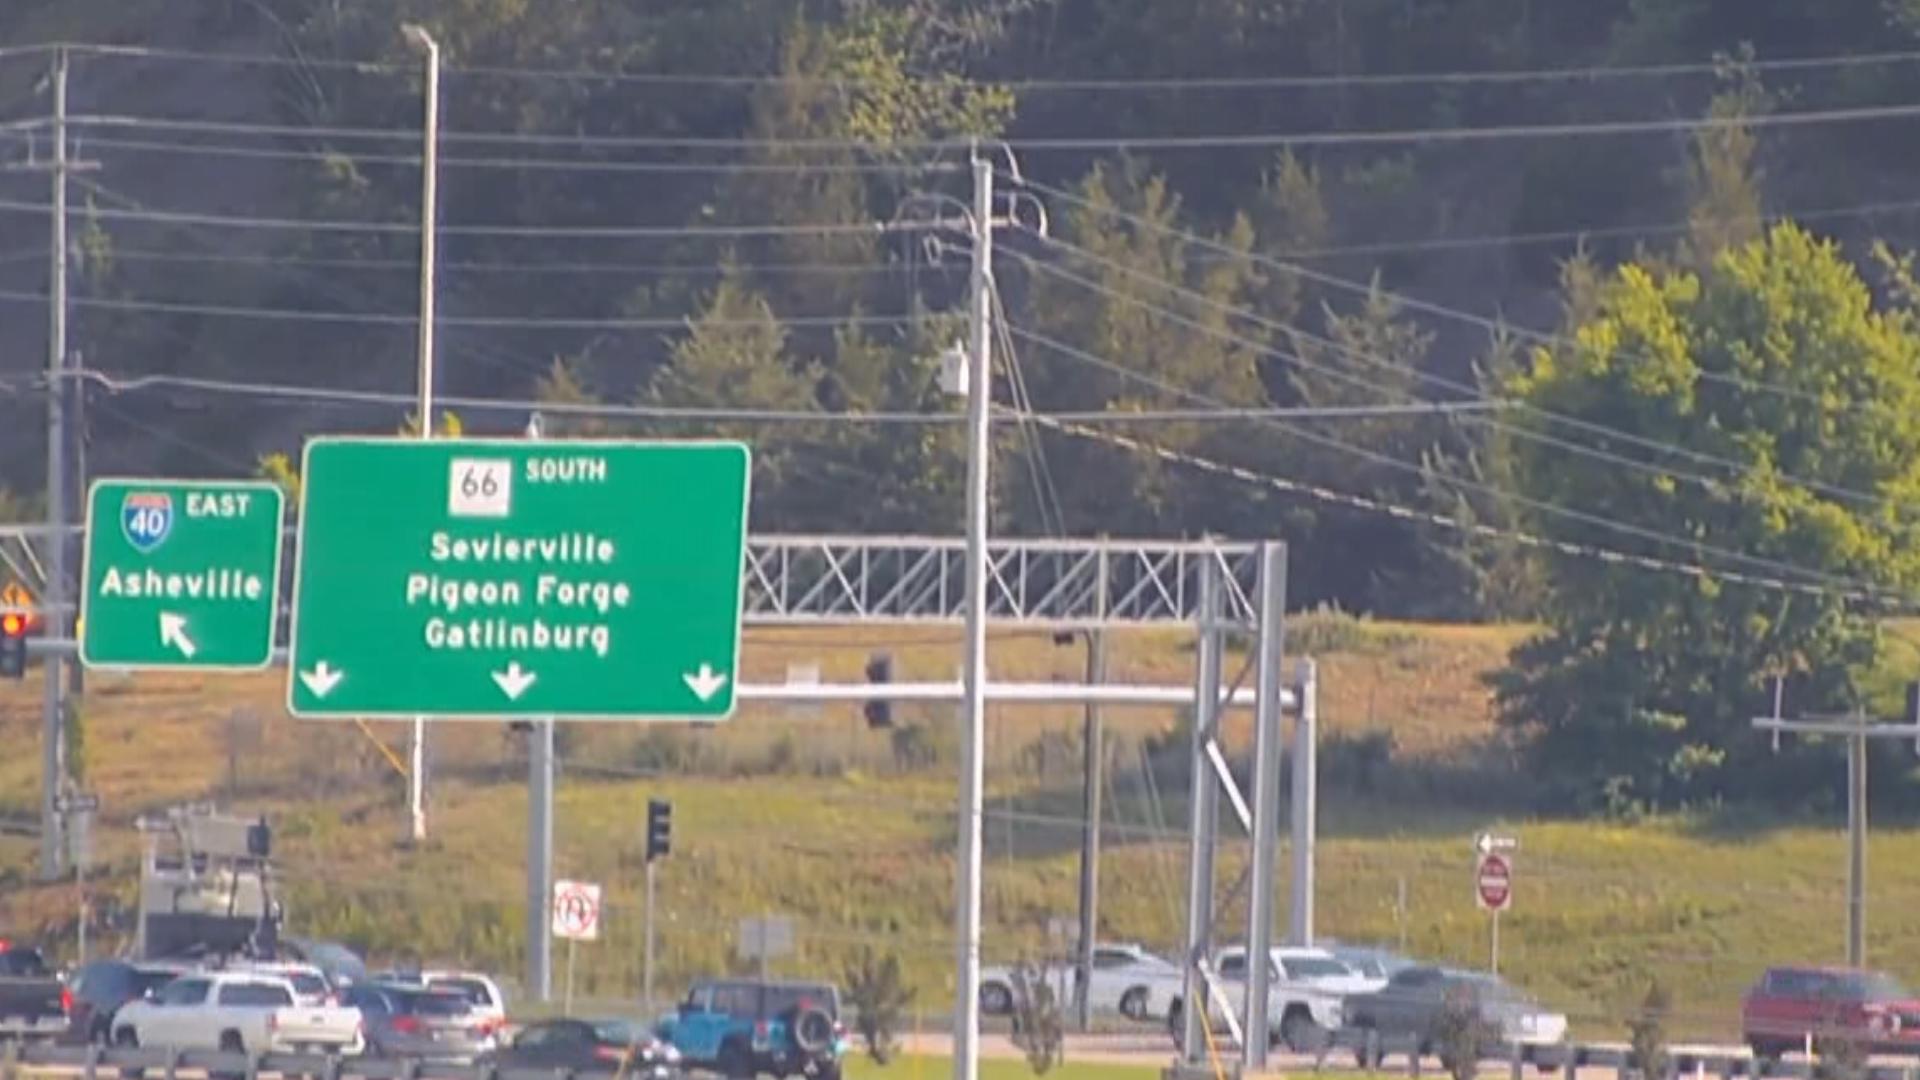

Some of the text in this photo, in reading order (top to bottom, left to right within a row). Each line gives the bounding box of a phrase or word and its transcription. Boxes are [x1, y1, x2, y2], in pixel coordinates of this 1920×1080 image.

[461, 457, 606, 498] 66 SOUTH
[129, 509, 163, 536] 40
[186, 492, 250, 517] EAST
[431, 532, 614, 562] Sevierville
[100, 566, 262, 600] Asheville
[406, 574, 631, 613] Pigeon Forge
[425, 617, 610, 657] Gatlinburg
